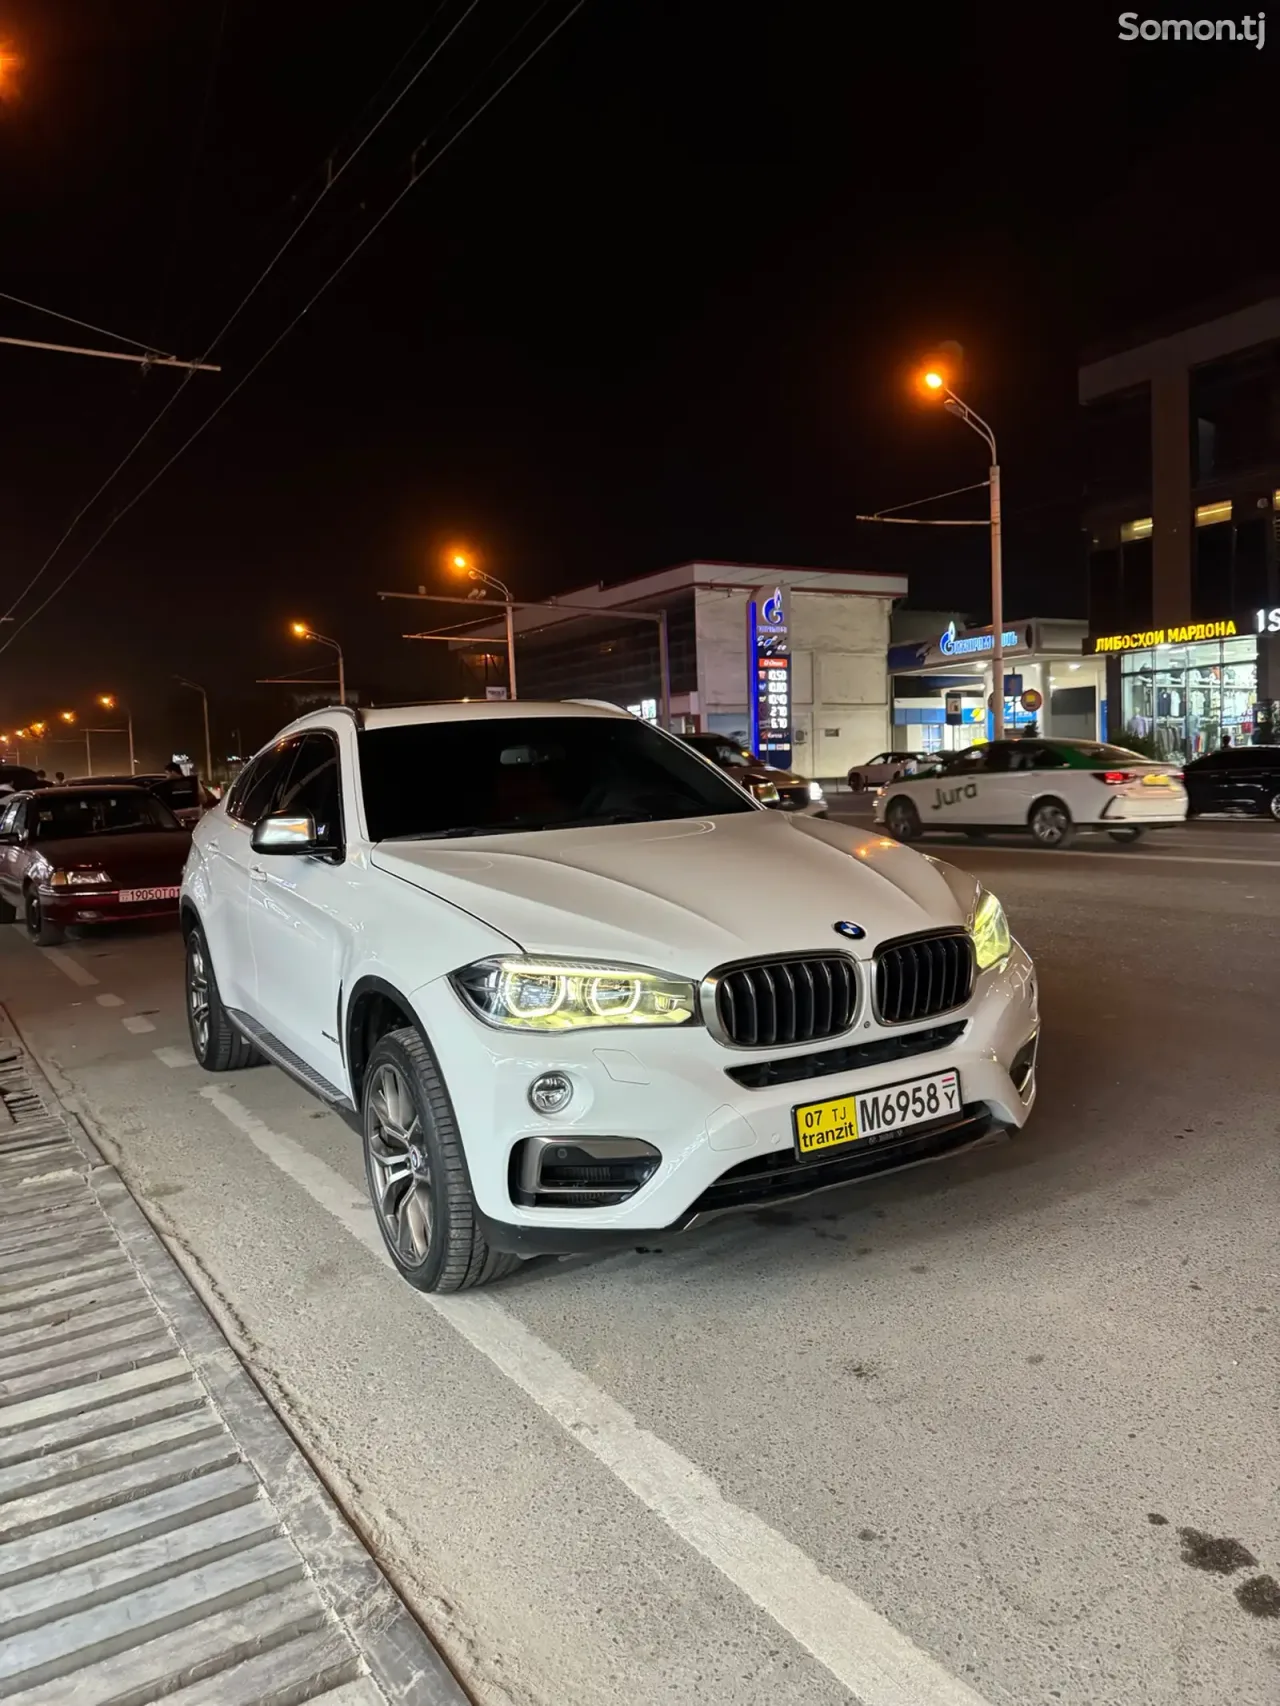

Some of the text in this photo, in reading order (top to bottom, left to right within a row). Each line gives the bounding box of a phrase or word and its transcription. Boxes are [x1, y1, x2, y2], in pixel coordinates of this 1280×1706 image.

[1168, 620, 1237, 643] МАРДОНА
[931, 783, 977, 810] Jura
[804, 1107, 847, 1129] 07 TJ
[860, 1082, 940, 1133] M6958
[802, 1121, 855, 1149] tranzit
